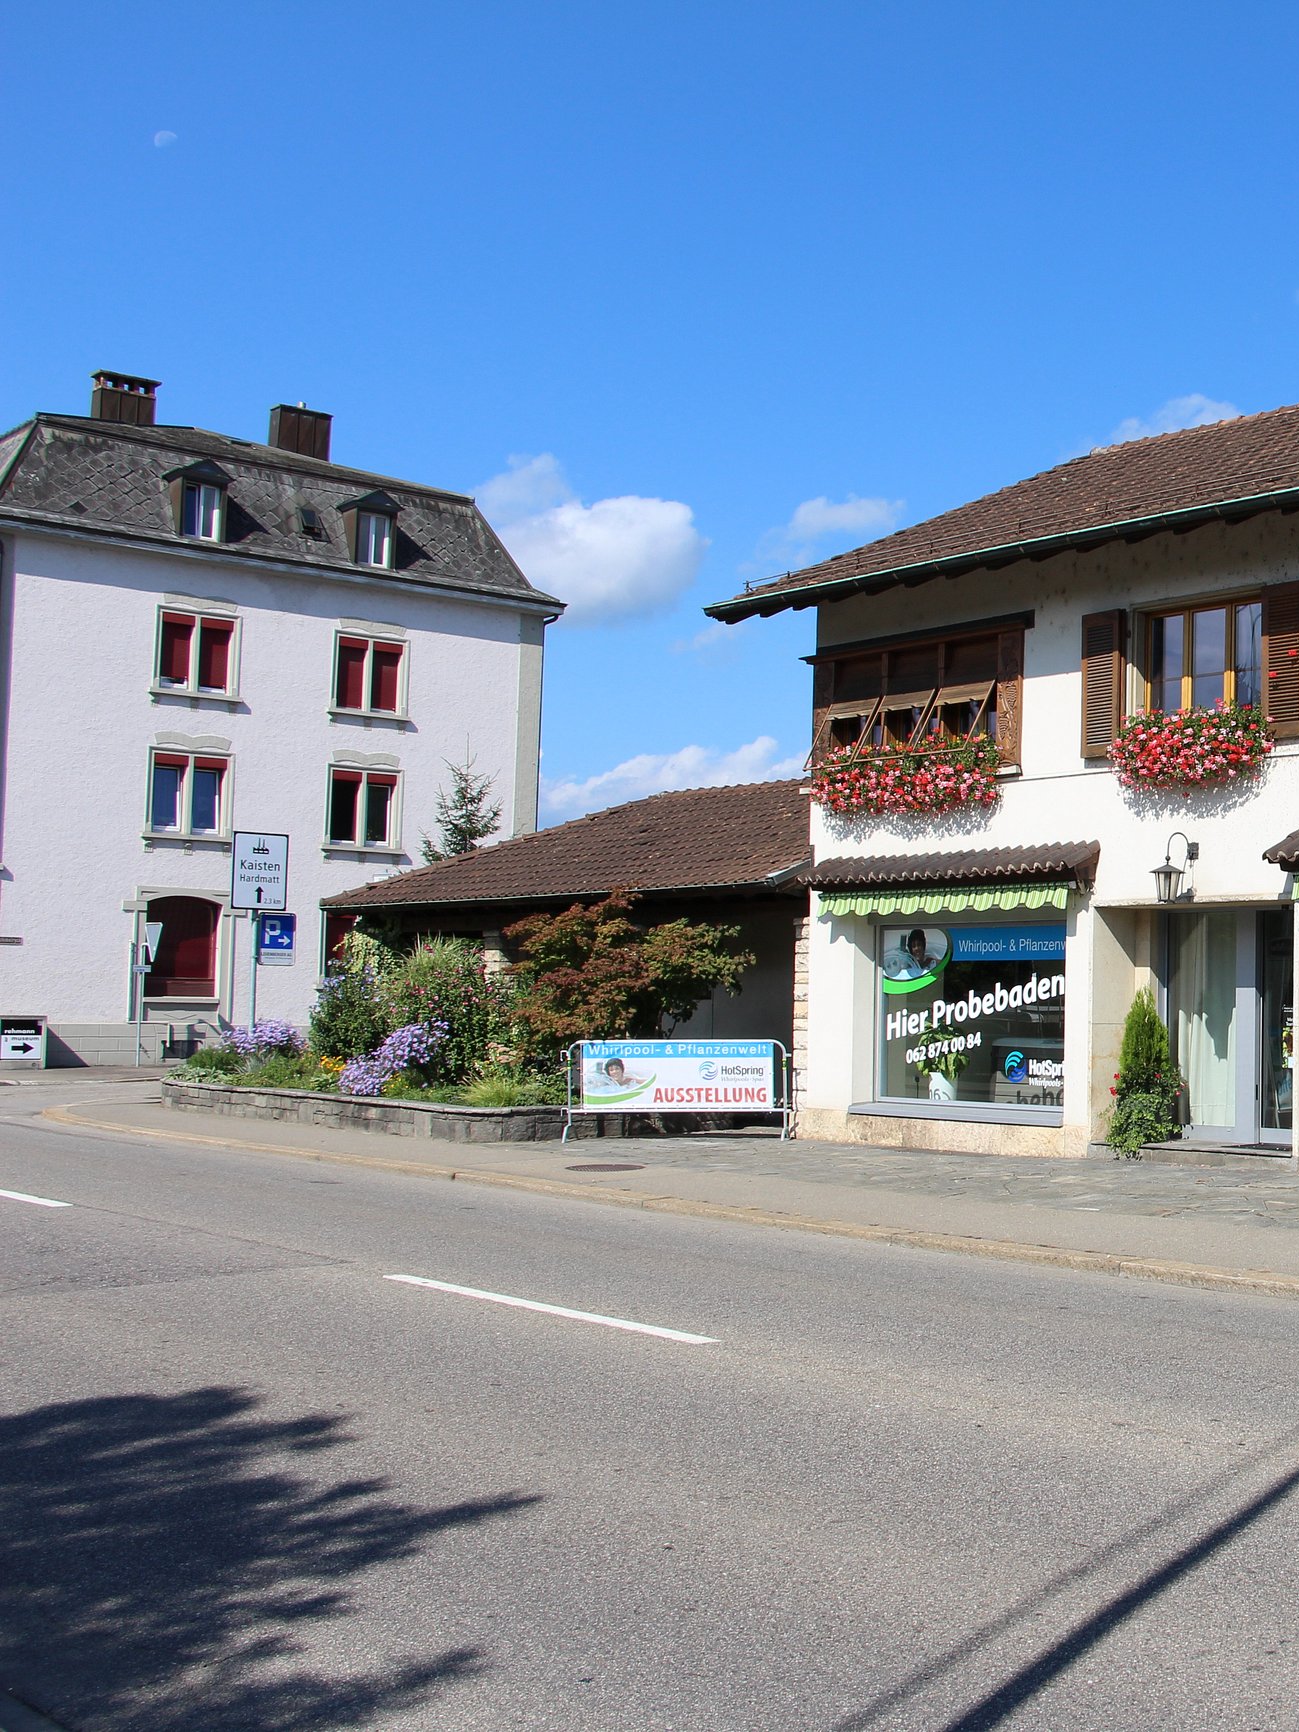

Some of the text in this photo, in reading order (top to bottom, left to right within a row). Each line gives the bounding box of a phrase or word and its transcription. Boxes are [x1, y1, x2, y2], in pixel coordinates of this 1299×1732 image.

[240, 860, 281, 872] Kaisten
[240, 874, 280, 884] Hardmatt
[264, 920, 281, 945] P
[958, 939, 1006, 955] Whirlpool-
[1009, 938, 1016, 952] &
[886, 972, 1065, 1041] Hier Probebaden
[588, 1044, 767, 1056] Whirlpool- & Pflanzenwelt
[905, 1031, 982, 1064] 062 874 00 84
[721, 1065, 764, 1077] HotSpring
[1029, 1059, 1064, 1078] HotSpri
[653, 1087, 767, 1103] AUSSTELLUNG
